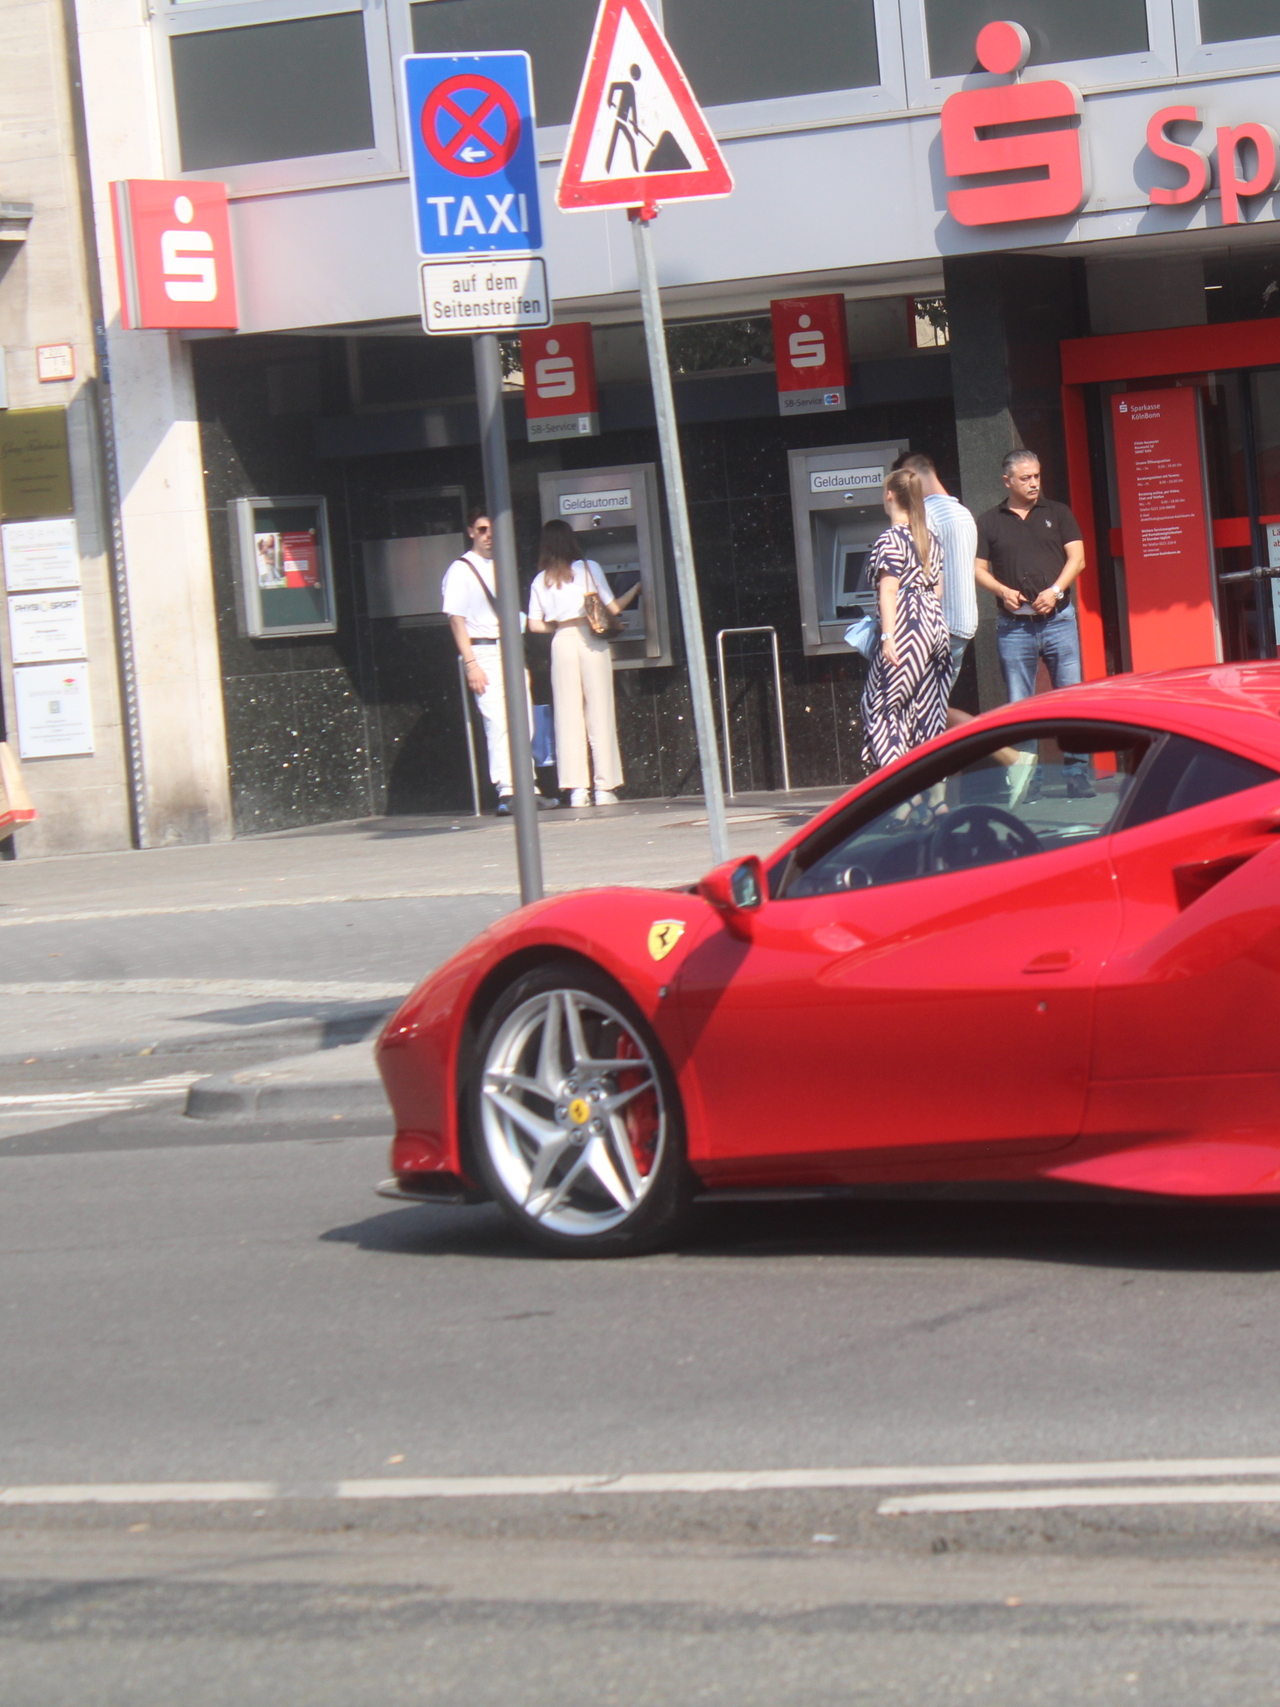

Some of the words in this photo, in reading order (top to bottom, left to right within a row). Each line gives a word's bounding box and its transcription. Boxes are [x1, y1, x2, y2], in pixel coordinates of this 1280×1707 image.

[426, 193, 529, 236] TAXI
[452, 274, 476, 292] auf
[486, 273, 517, 291] dem
[433, 296, 540, 319] Seitenstreifen
[784, 397, 823, 408] SB-Service
[1130, 404, 1161, 413] Sparkasse
[1131, 412, 1161, 420] KölnBonn
[531, 422, 577, 434] SB-Service
[813, 473, 882, 488] Geldautomat
[562, 495, 628, 510] Geldautomat
